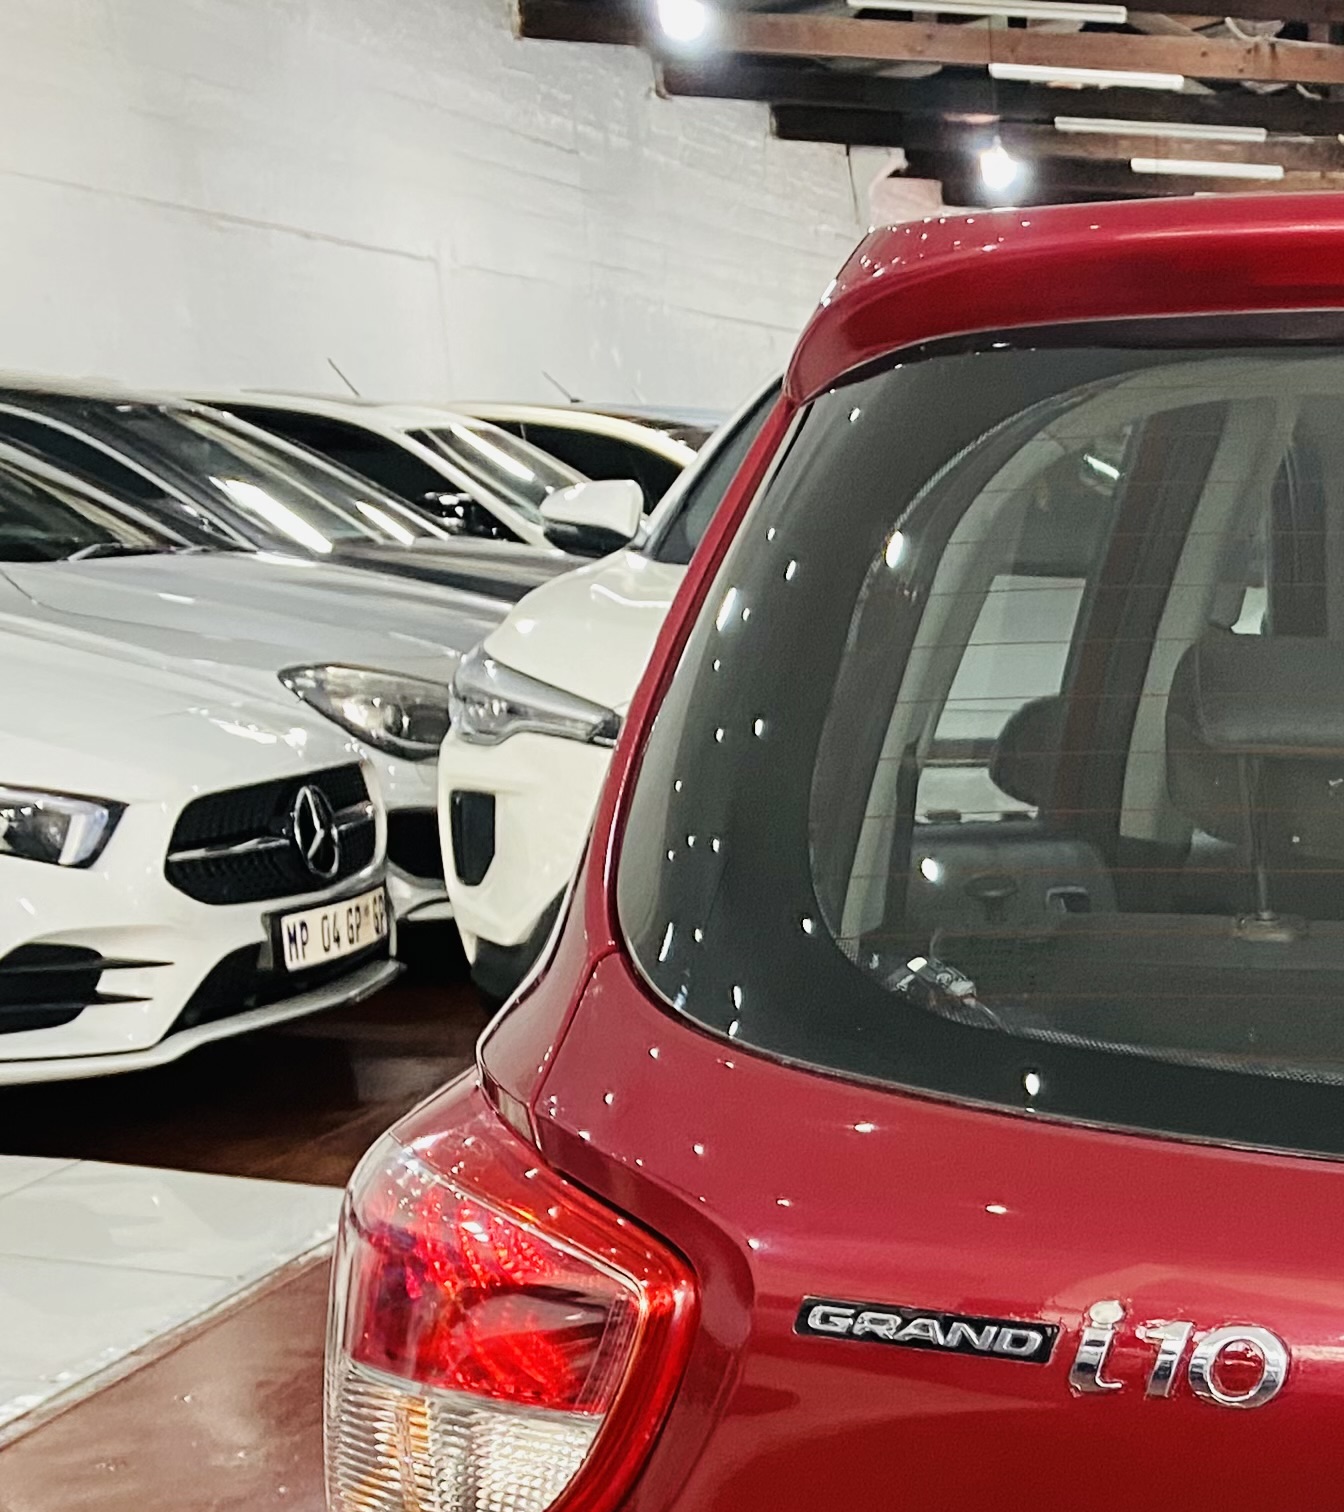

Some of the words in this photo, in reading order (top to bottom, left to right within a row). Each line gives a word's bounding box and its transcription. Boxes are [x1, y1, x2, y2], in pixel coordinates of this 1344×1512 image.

[287, 920, 309, 962] MP
[321, 911, 341, 953] 04
[807, 1304, 1045, 1356] GRAND
[1069, 1299, 1290, 1409] i10
